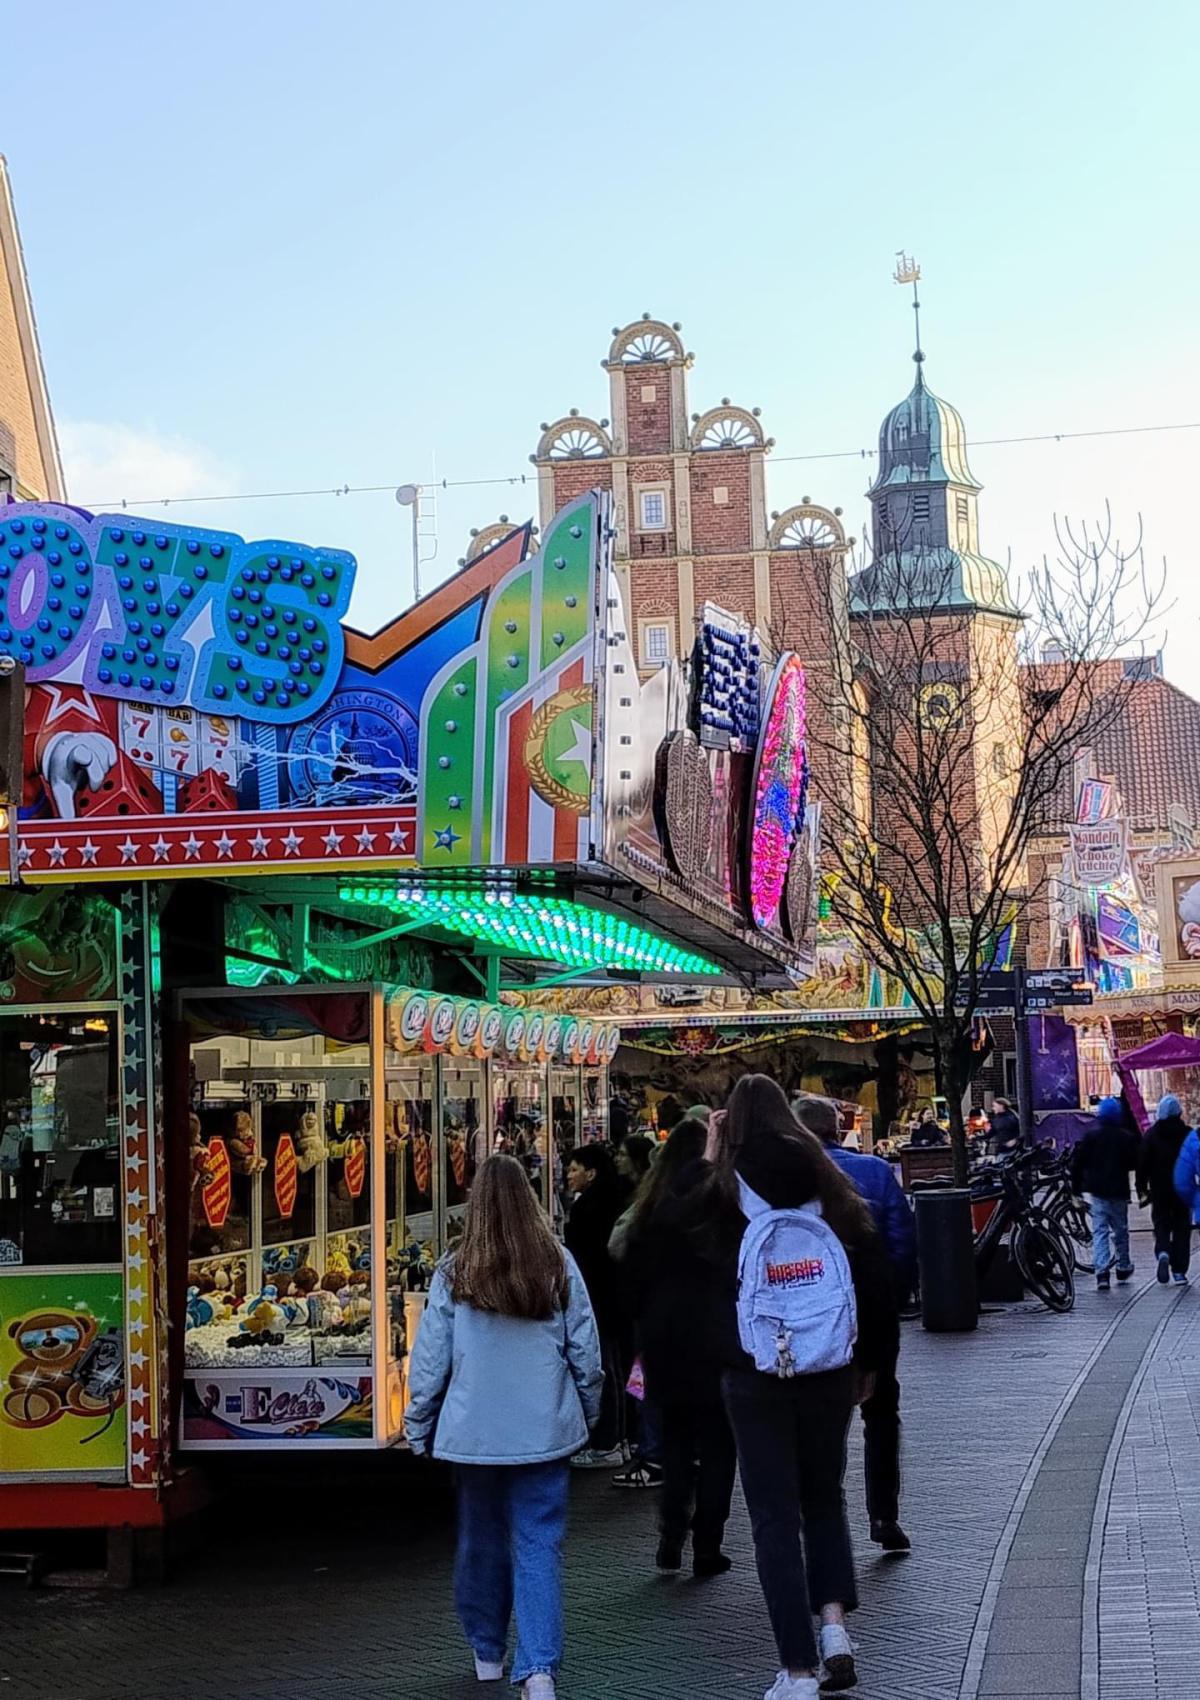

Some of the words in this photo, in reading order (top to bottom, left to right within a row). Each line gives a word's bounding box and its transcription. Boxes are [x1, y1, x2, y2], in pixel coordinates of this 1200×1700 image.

[167, 708, 191, 721] BAR
[132, 716, 150, 738] 7
[171, 749, 189, 771] 7
